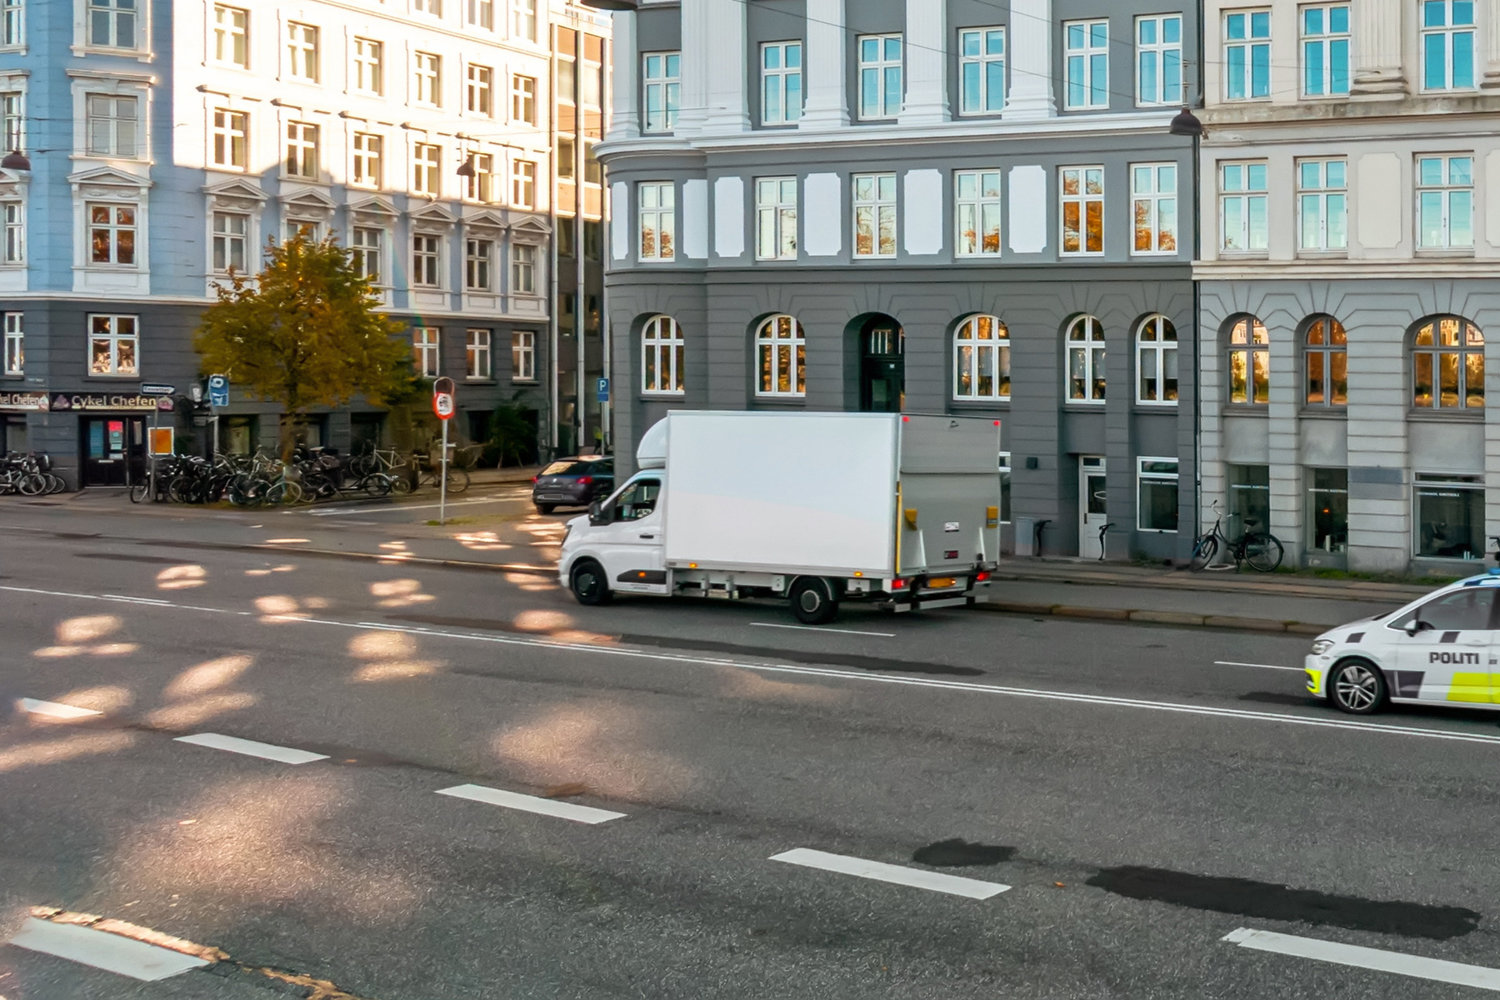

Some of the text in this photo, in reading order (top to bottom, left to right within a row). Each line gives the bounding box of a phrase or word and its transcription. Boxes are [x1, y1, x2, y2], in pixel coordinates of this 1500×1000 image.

[599, 380, 607, 391] P
[71, 395, 156, 407] Cykel Chefen
[1429, 652, 1479, 664] POLITI
